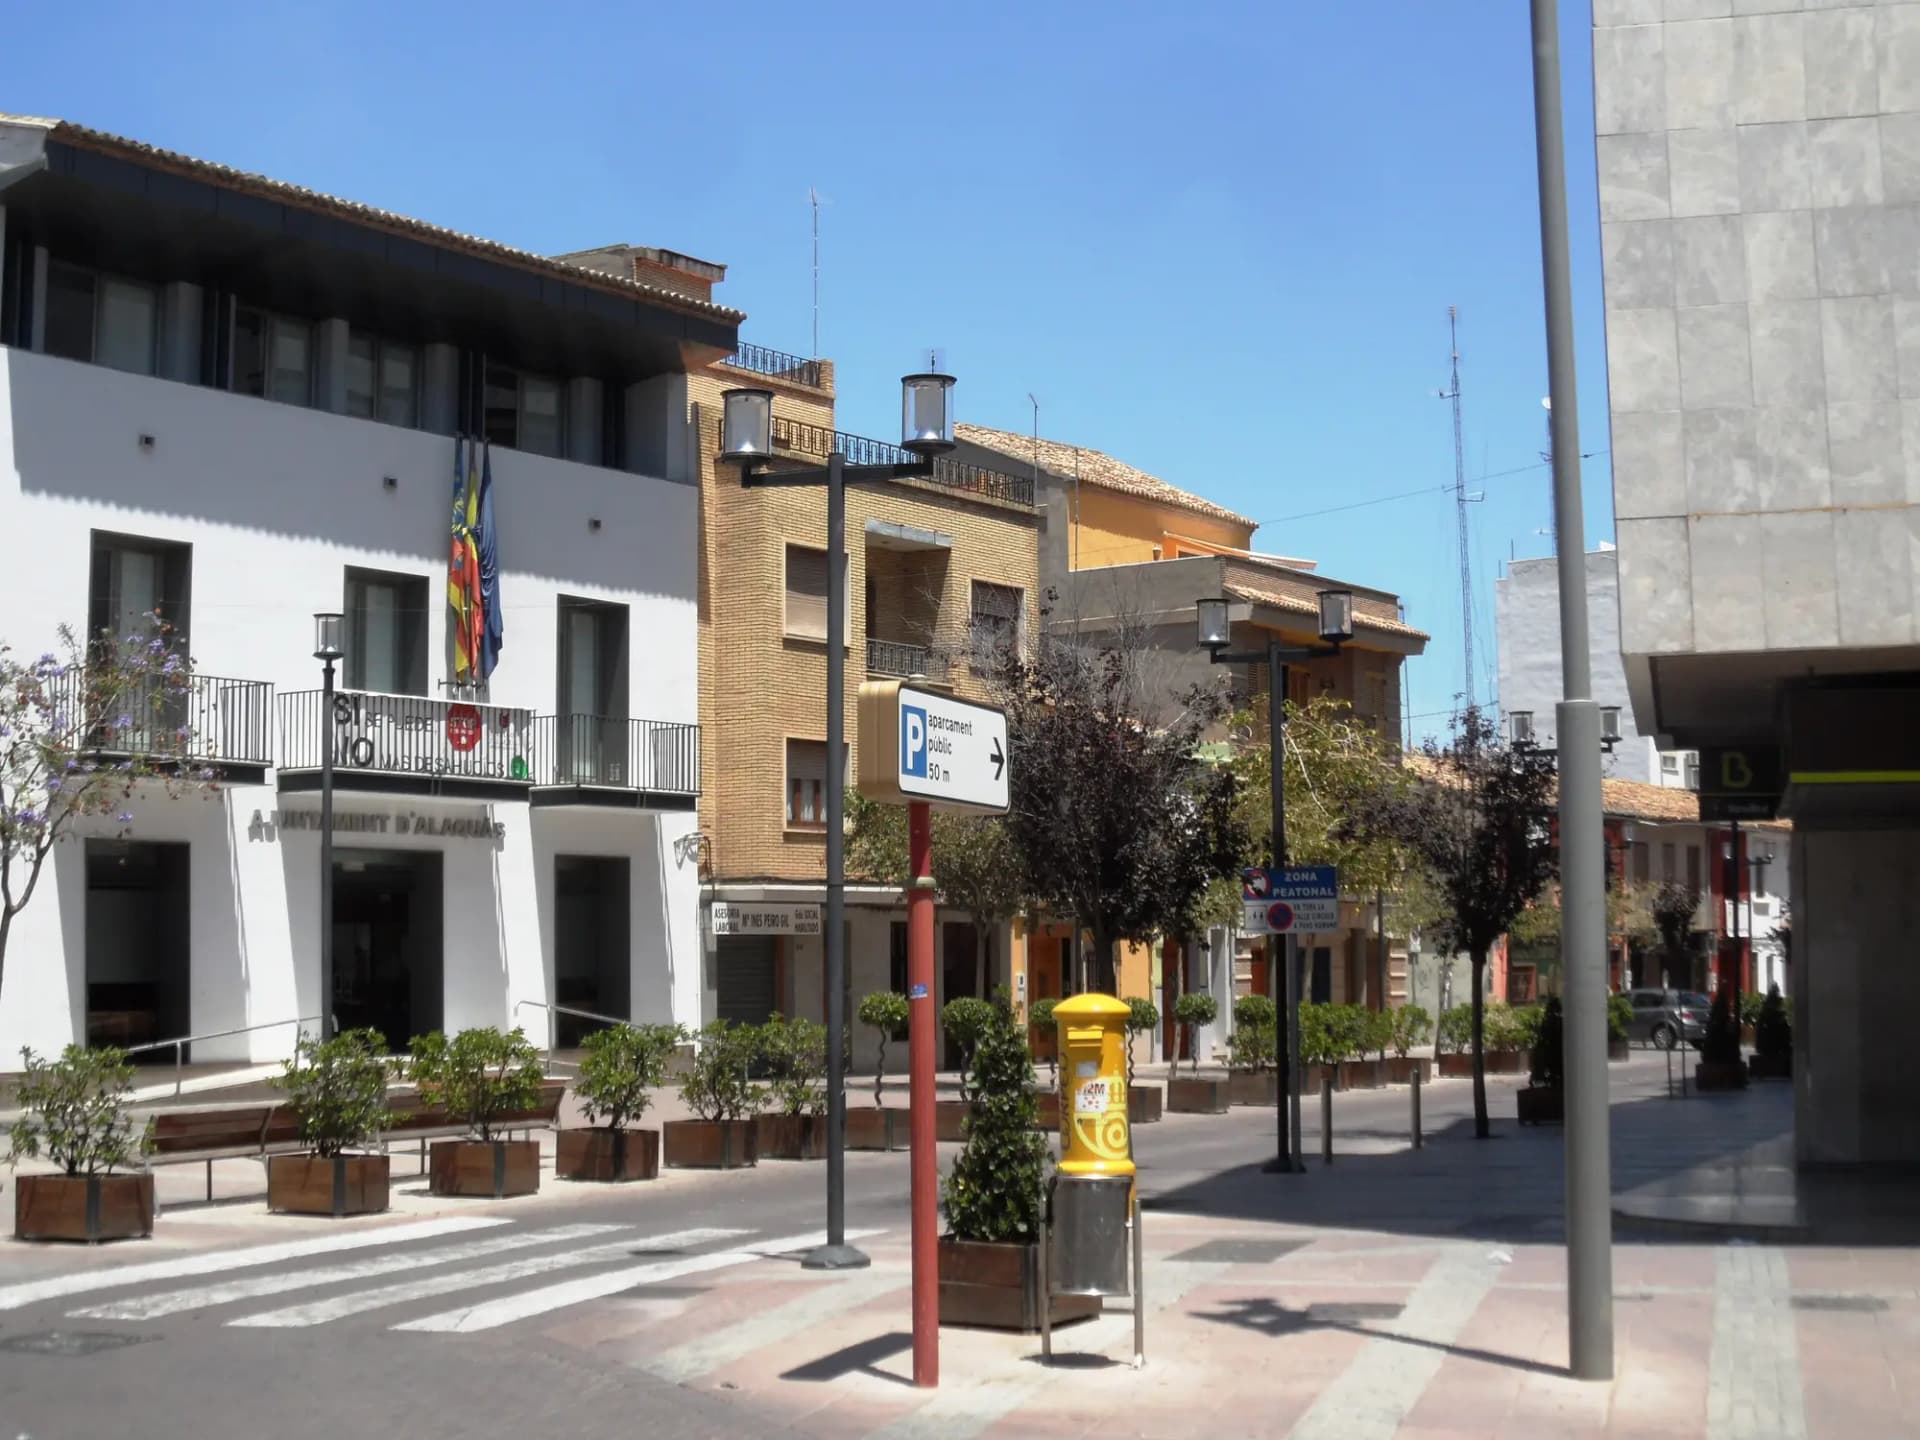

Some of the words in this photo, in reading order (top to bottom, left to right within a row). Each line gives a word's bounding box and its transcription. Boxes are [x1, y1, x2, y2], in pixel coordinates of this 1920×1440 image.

[928, 714, 973, 736] aparcament
[906, 712, 924, 770] P
[928, 736, 953, 755] públic
[928, 763, 940, 781] 50
[942, 770, 950, 782] m
[1285, 872, 1318, 882] ZONA
[1272, 887, 1335, 897] PEATONAL
